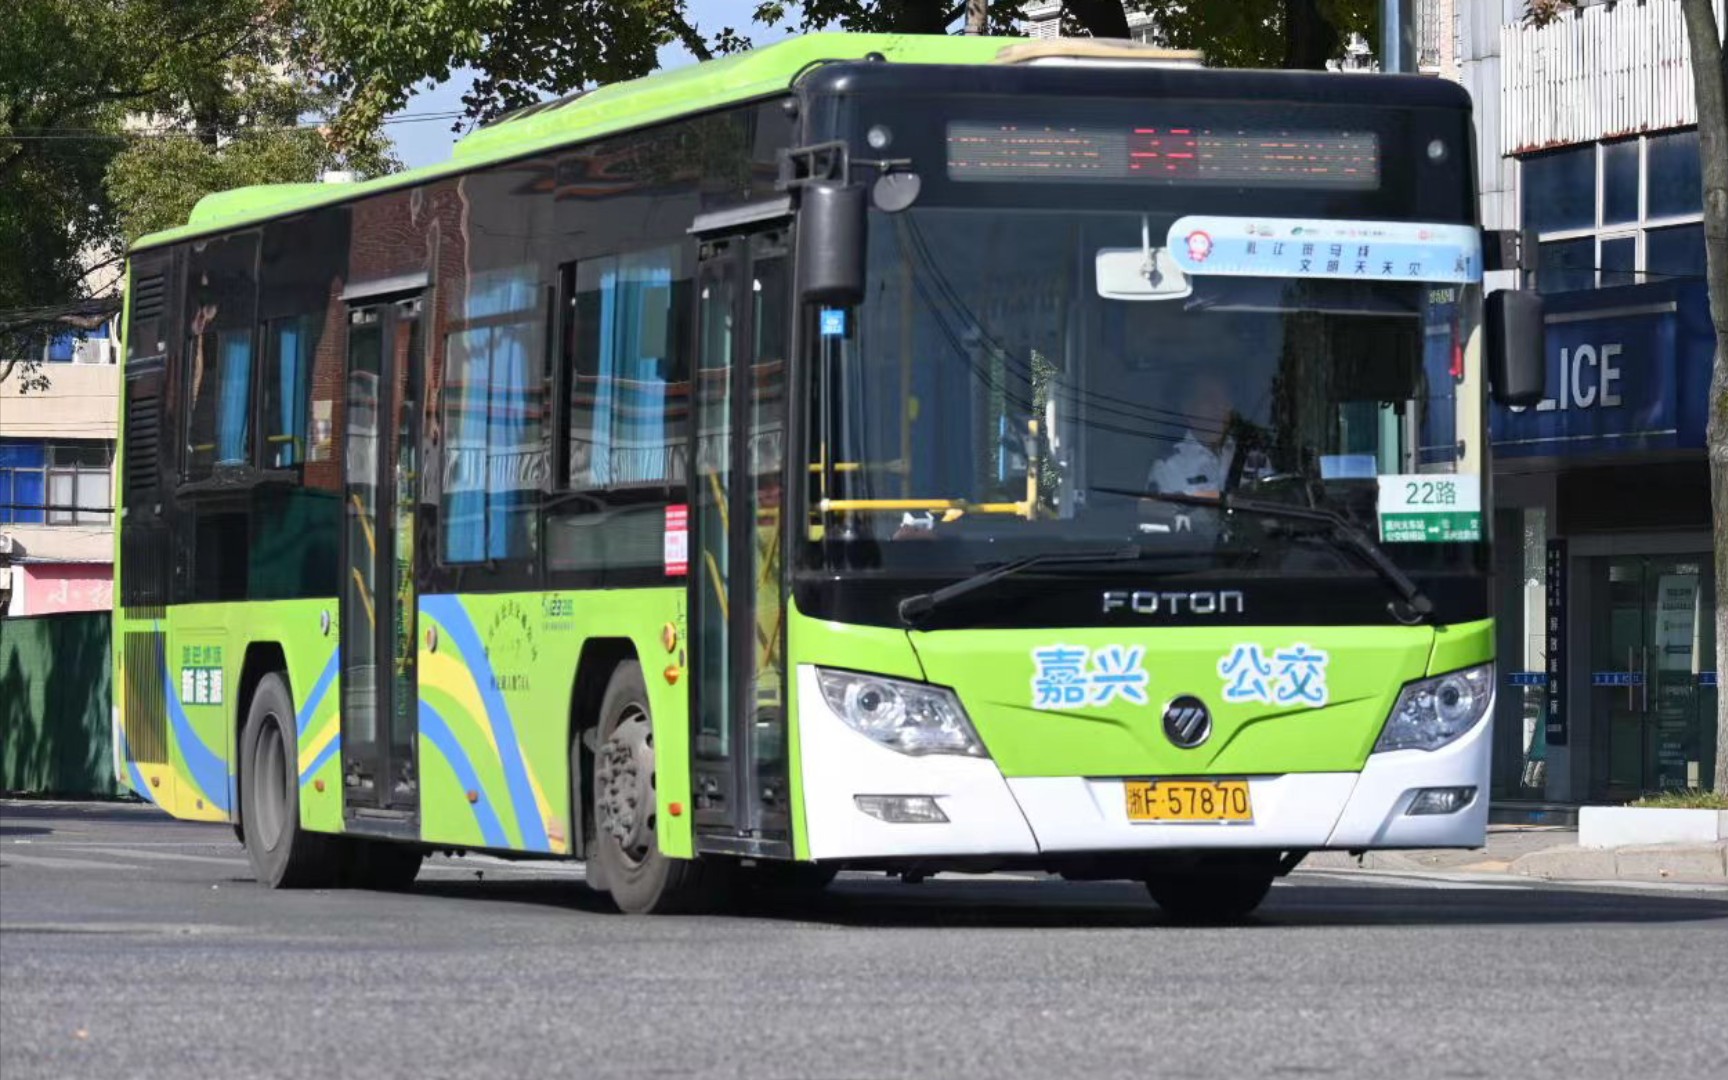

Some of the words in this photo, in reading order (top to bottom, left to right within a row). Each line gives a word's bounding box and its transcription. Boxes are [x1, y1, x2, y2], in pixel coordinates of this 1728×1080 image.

[1406, 481, 1456, 505] 22路
[1103, 590, 1244, 615] FOTON
[1035, 647, 1146, 705] 嘉兴
[1219, 645, 1326, 703] 公交
